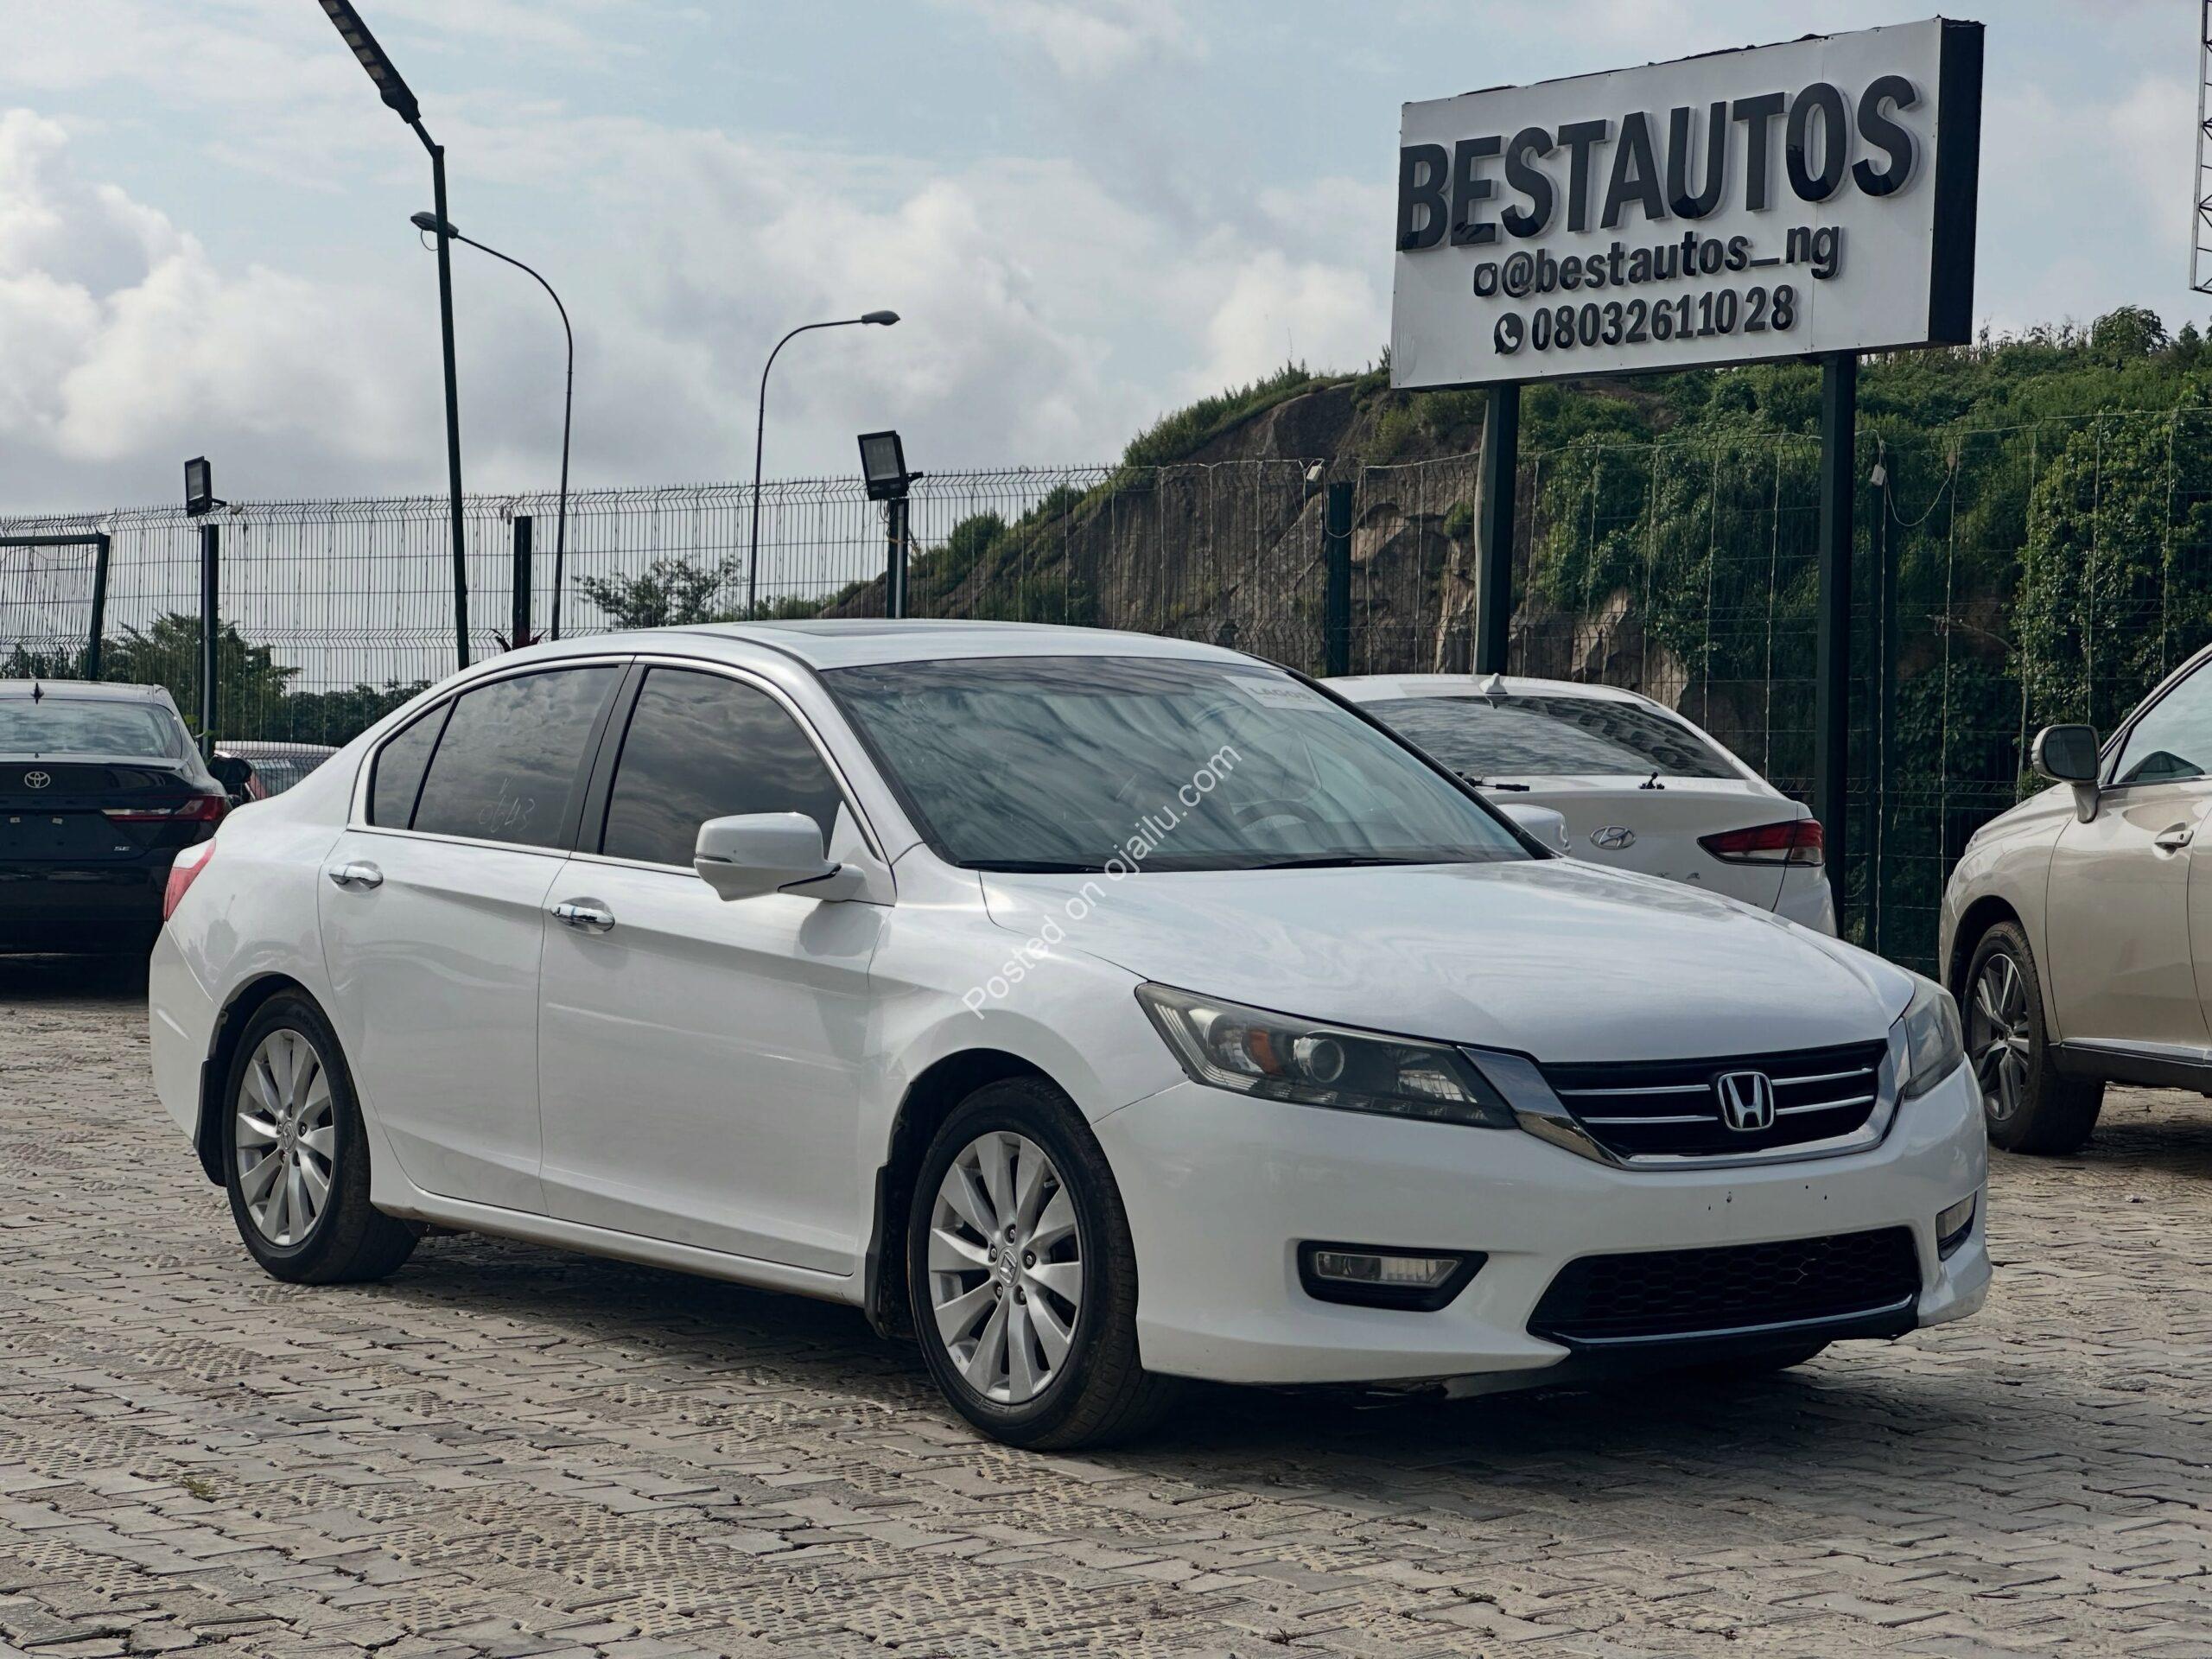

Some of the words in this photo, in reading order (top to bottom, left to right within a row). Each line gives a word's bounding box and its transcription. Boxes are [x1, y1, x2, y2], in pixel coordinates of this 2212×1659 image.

[1396, 74, 1918, 251] BESTAUTOS
[1502, 226, 1841, 298] @bestautos_ng
[1531, 284, 1795, 352] 08032611028
